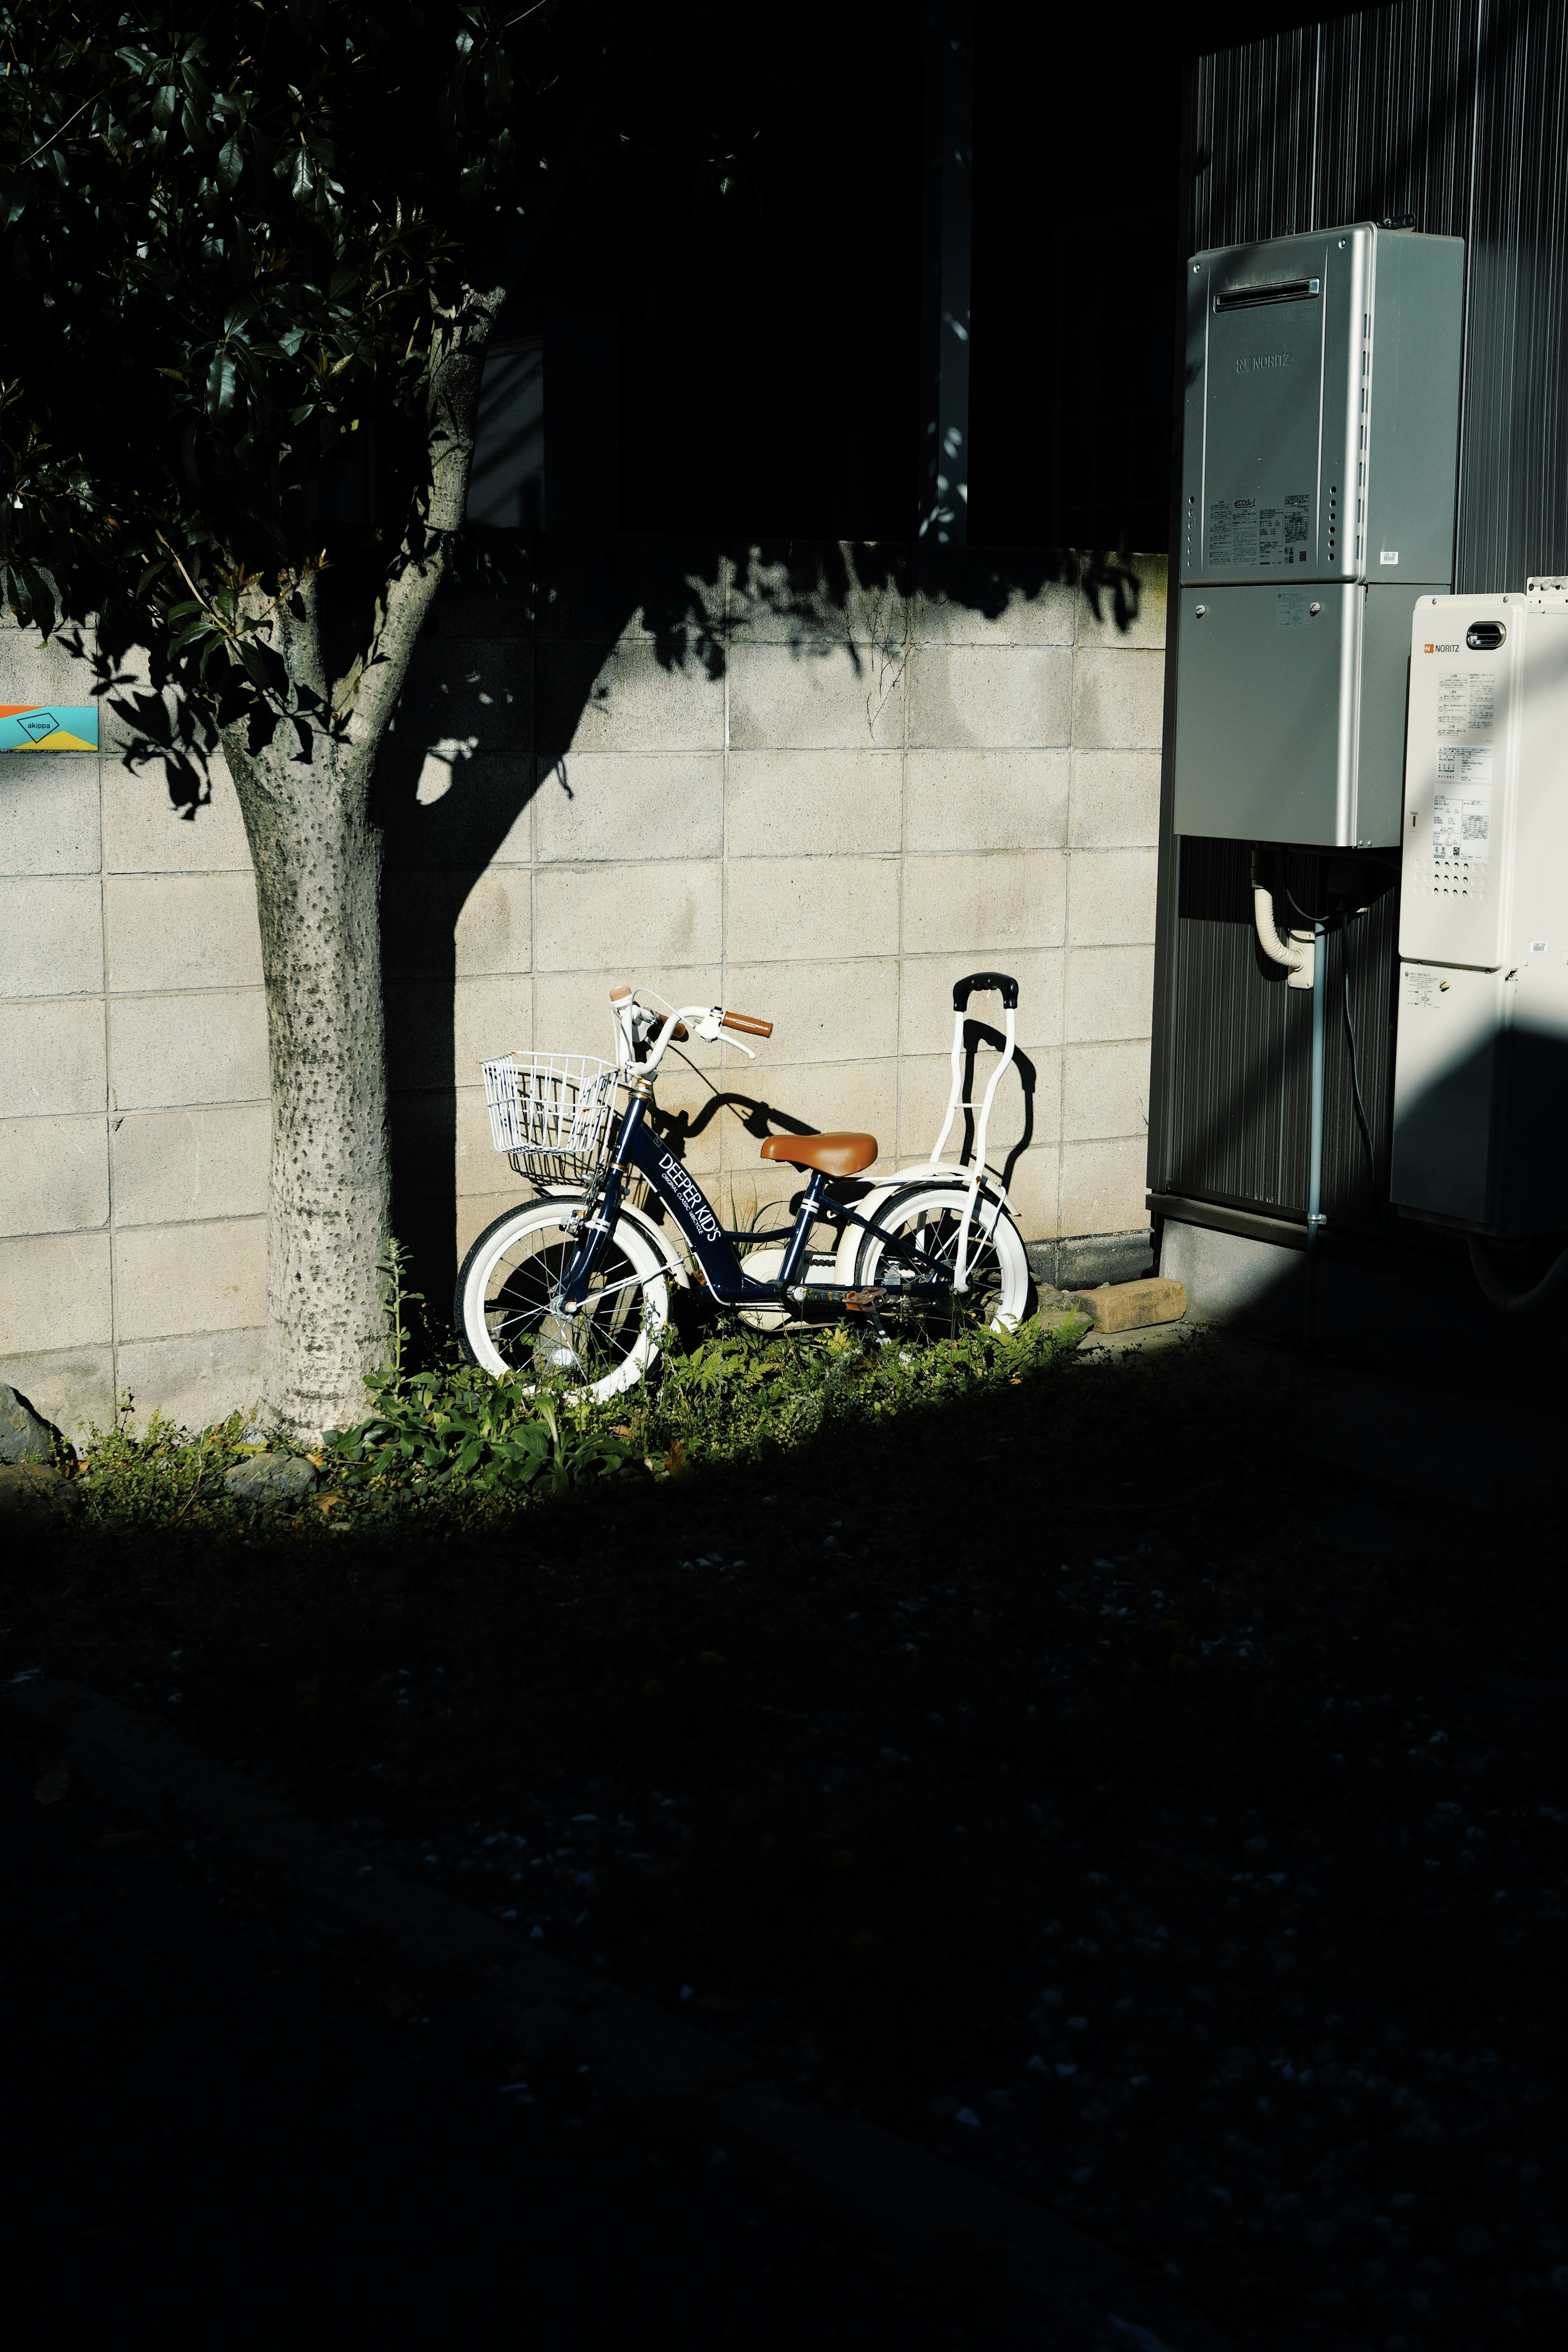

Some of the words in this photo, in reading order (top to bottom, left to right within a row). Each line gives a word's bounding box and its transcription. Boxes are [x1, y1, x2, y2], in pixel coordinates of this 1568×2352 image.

[1253, 352, 1291, 370] NORITZ
[659, 1153, 702, 1208] DEEPER
[695, 1205, 721, 1242] KID'S
[662, 1173, 678, 1193] ORIGINAL
[677, 1192, 690, 1211] CLASSIC
